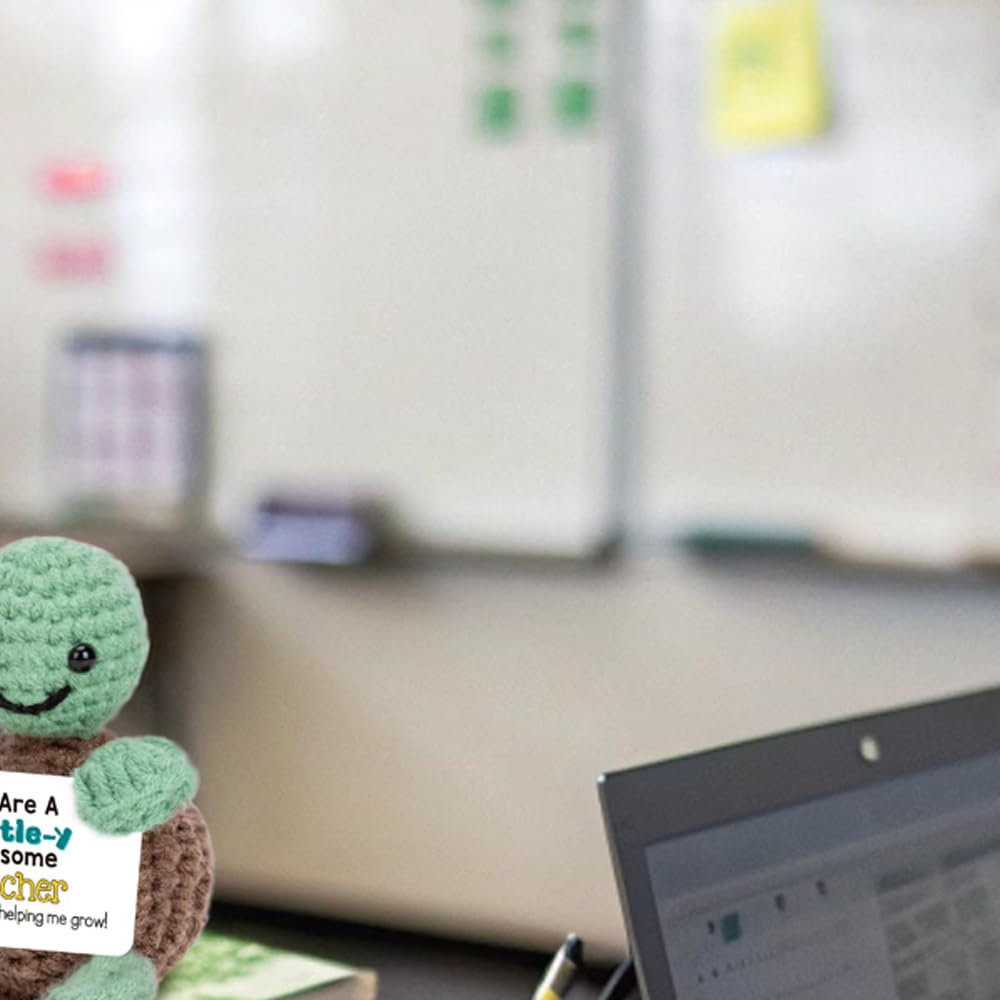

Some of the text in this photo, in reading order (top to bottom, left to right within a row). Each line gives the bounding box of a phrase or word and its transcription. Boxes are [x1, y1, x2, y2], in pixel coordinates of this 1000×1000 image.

[45, 796, 59, 816] A
[47, 913, 67, 925] me
[70, 912, 108, 930] grow!
